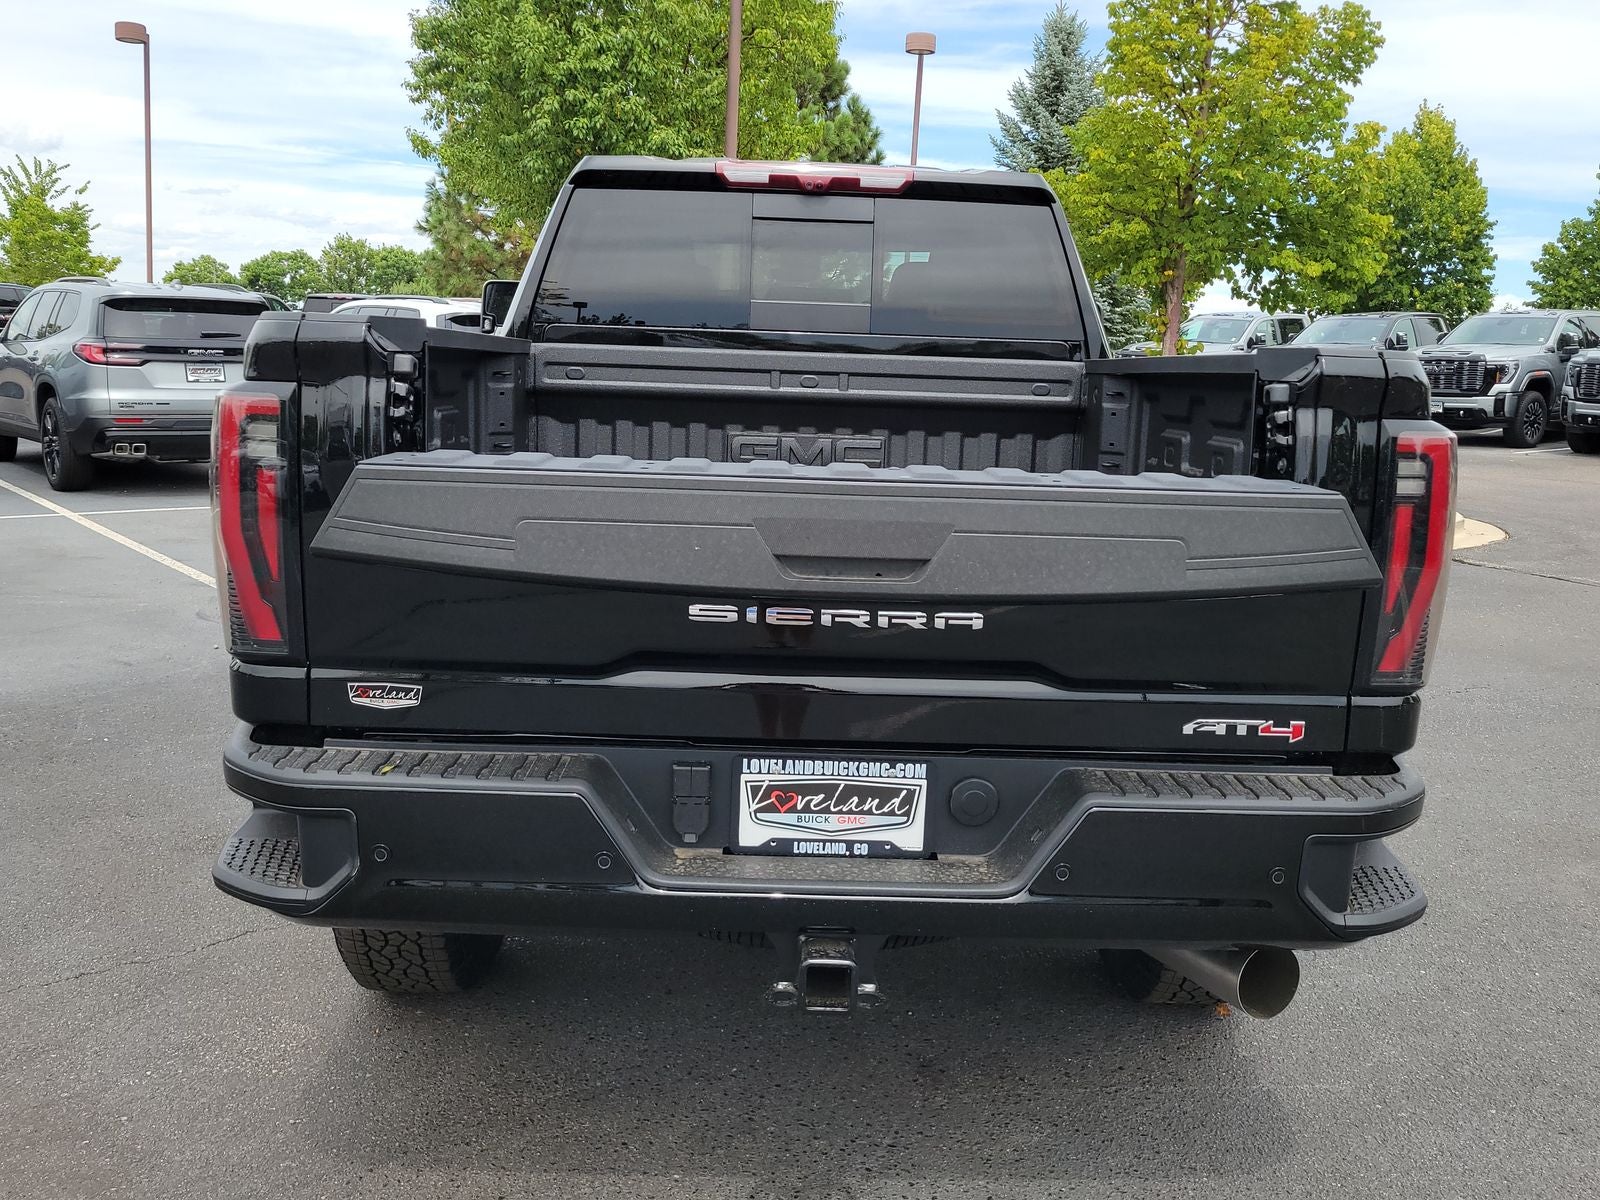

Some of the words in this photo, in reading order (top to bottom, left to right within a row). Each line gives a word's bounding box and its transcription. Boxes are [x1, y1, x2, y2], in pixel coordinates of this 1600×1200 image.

[188, 349, 224, 357] GMC
[731, 435, 882, 468] GMC
[688, 603, 985, 630] SIERRA
[1182, 718, 1306, 743] AT4
[796, 815, 831, 824] BUICK
[837, 816, 867, 825] GMC
[793, 841, 849, 856] LOVELAND,
[853, 843, 869, 855] CO
